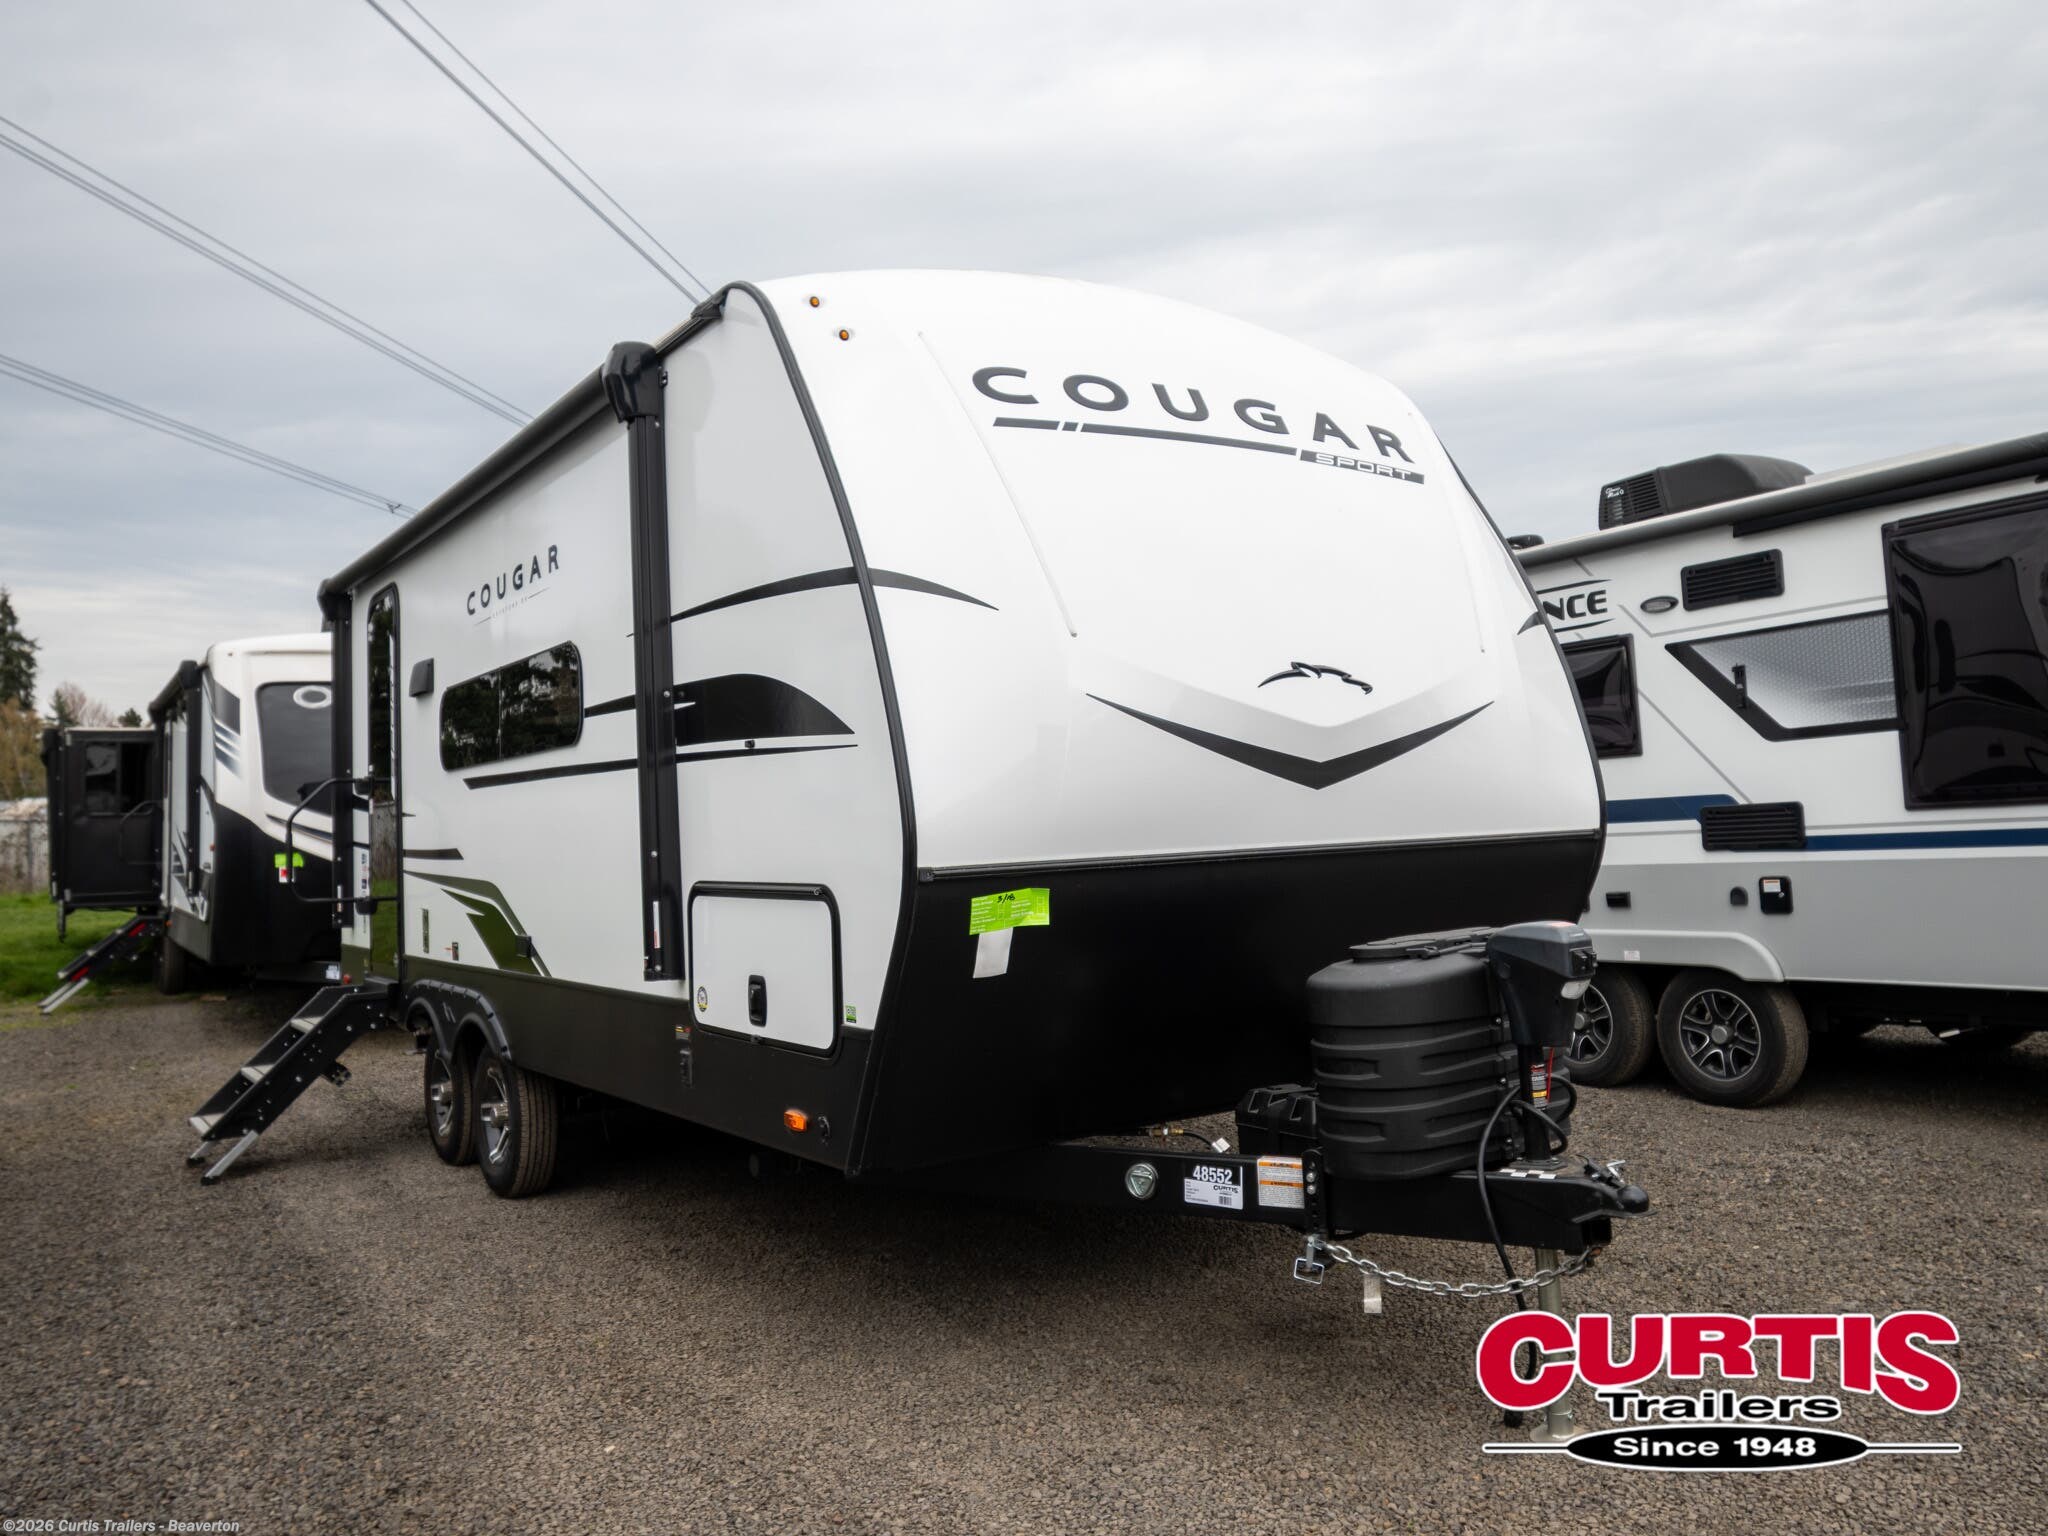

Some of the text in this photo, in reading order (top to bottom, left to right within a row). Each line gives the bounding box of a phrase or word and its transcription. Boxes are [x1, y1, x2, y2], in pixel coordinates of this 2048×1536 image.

[972, 366, 1415, 463] COUGAR
[1315, 452, 1412, 480] SPORT
[466, 544, 559, 616] COUGAR
[1192, 1165, 1233, 1185] 48552
[1213, 1184, 1239, 1194] CURTIS
